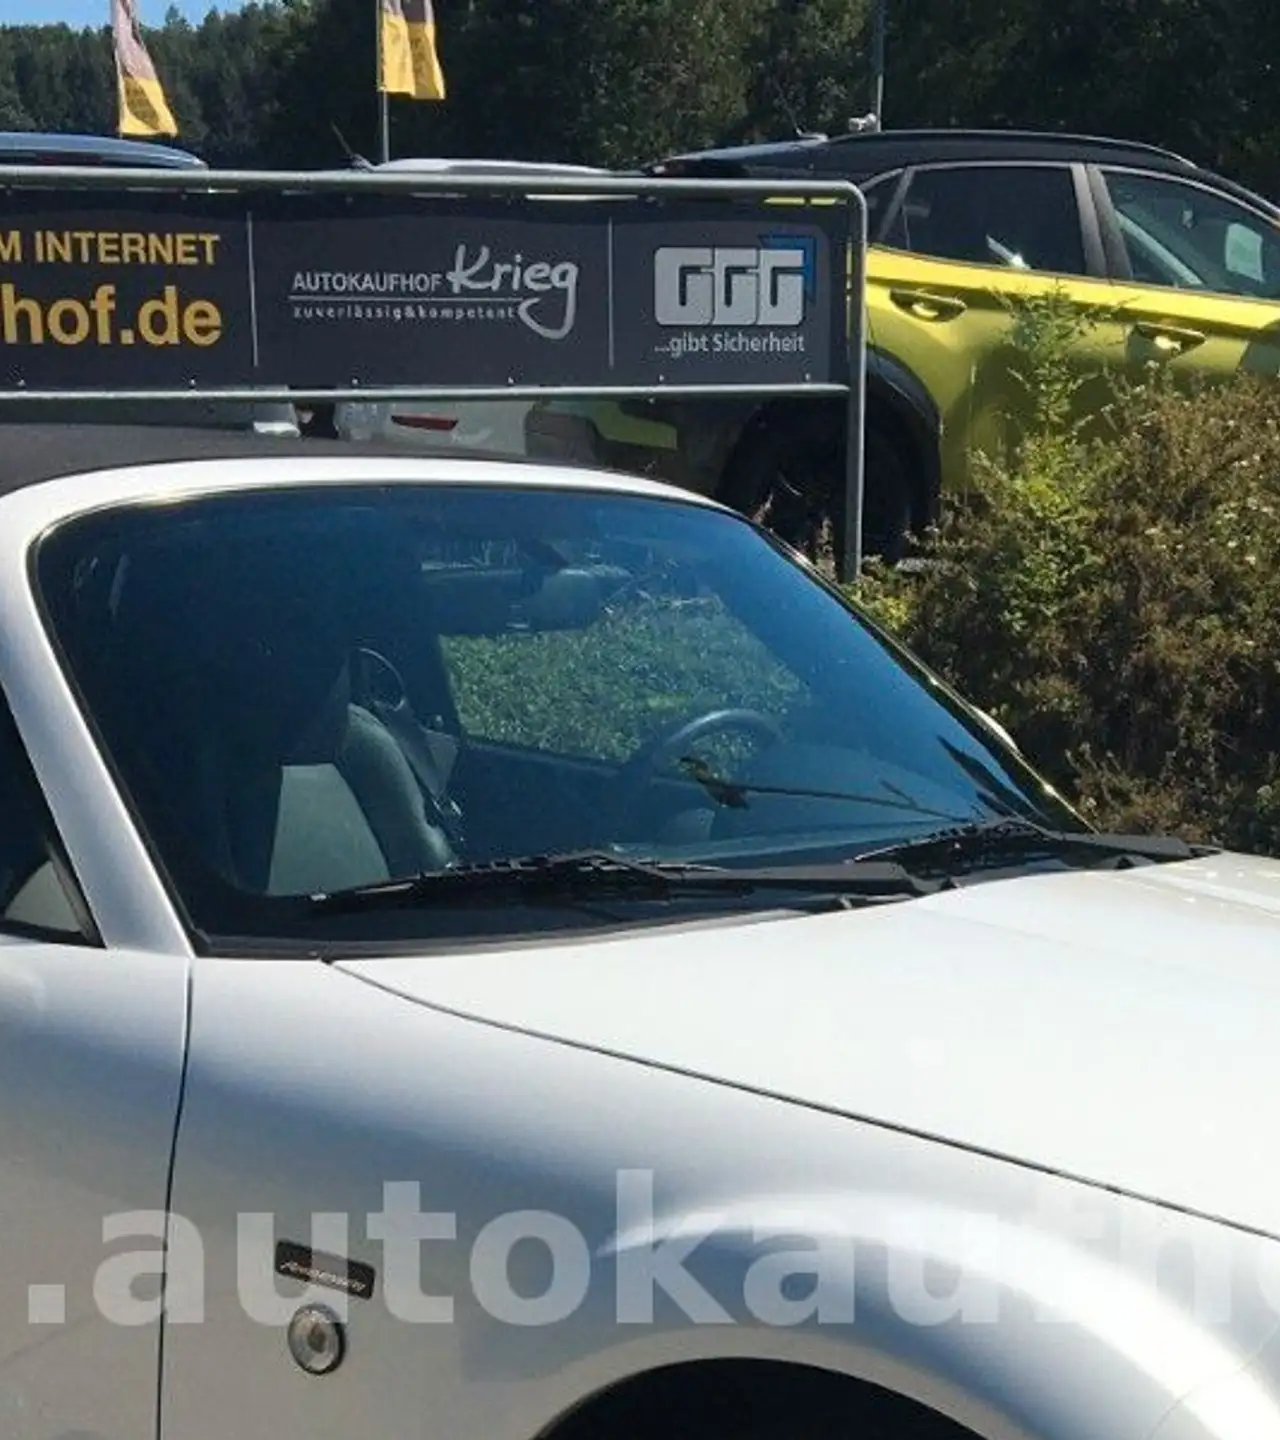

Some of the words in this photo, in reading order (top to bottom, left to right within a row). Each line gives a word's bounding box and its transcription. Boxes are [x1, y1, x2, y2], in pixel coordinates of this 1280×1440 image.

[35, 231, 220, 265] INTERNET
[292, 271, 443, 292] AUTOKAUFHOF
[446, 244, 579, 339] Krieg
[713, 331, 805, 352] Sicherheit
